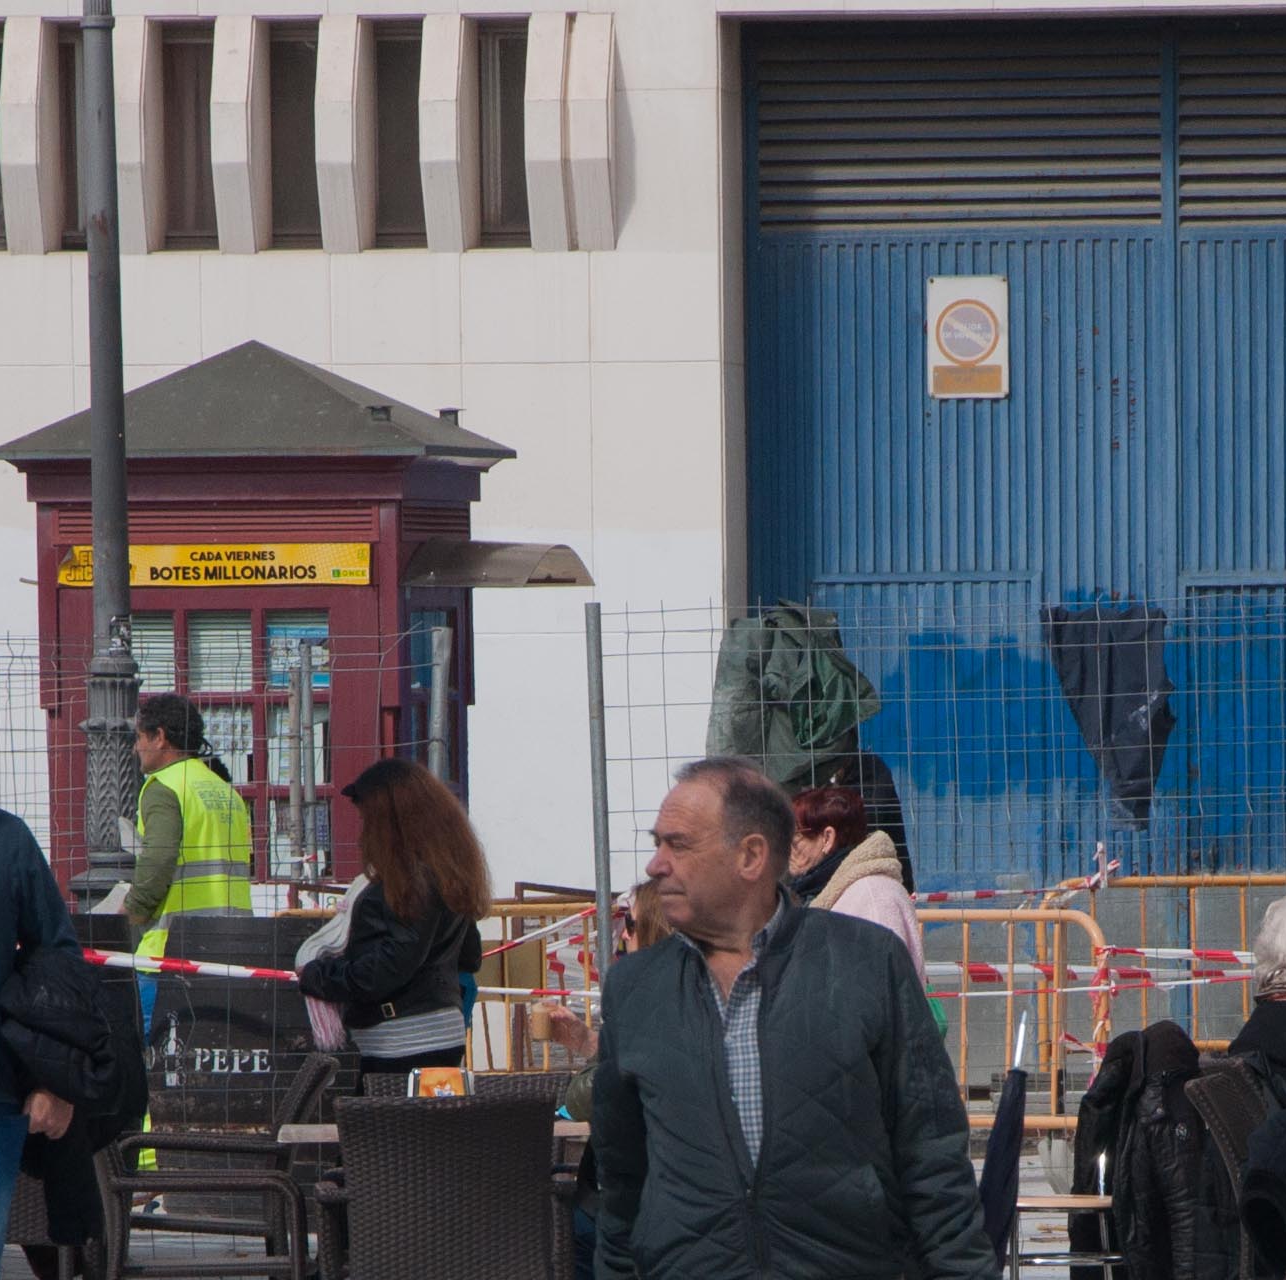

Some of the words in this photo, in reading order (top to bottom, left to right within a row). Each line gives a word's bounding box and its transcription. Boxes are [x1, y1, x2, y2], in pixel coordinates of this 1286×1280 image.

[190, 551, 223, 561] CADA
[225, 550, 276, 561] VIERNES
[149, 566, 202, 581] BOTES
[203, 564, 317, 581] MILLONARIOS
[194, 1047, 271, 1074] PEPE
